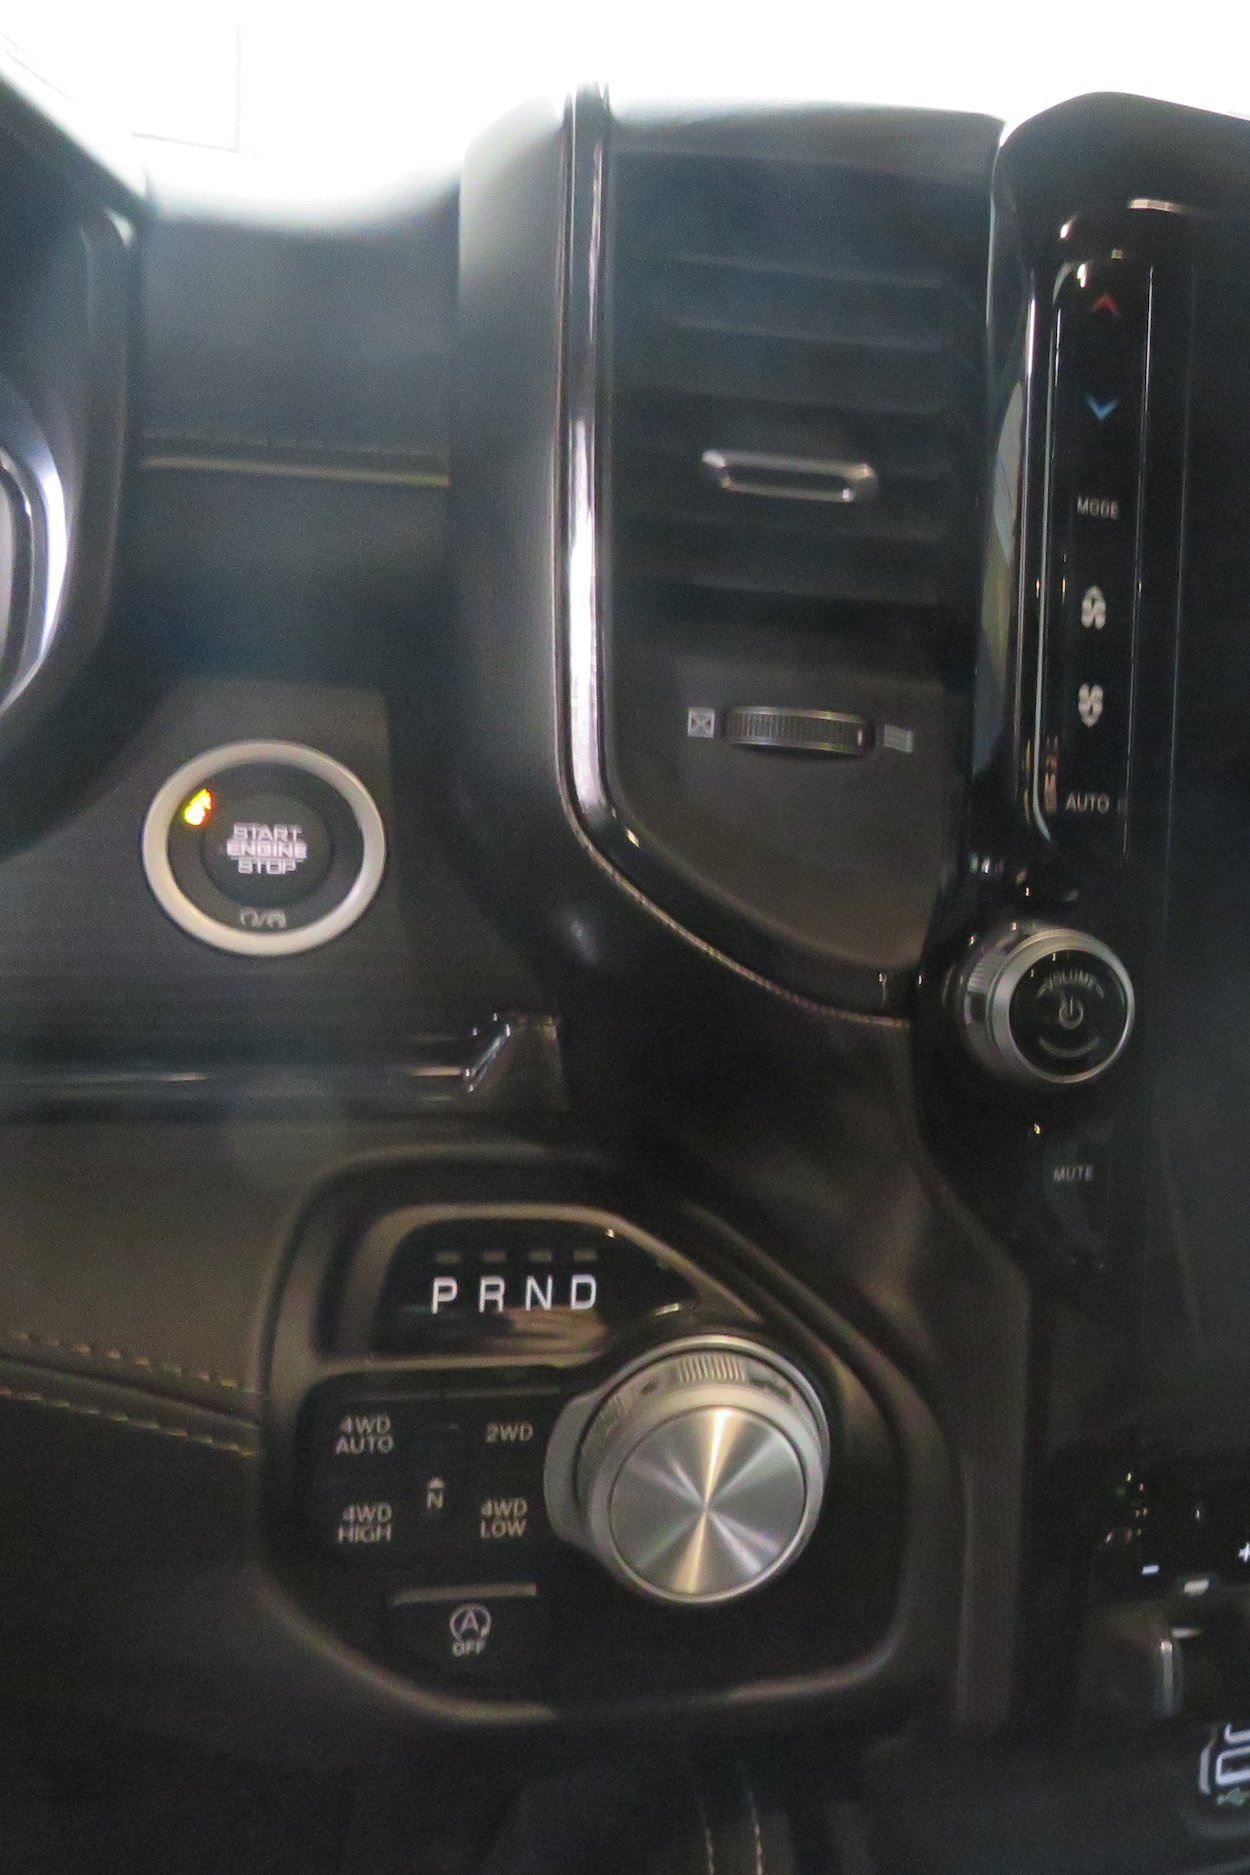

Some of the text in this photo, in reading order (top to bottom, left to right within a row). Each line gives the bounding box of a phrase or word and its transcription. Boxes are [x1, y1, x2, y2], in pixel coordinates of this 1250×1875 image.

[1065, 793, 1110, 814] AUTO
[233, 822, 303, 841] START
[226, 839, 308, 862] ENGINE
[237, 858, 297, 875] STOP
[431, 1273, 597, 1315] P R N D
[340, 1413, 392, 1434] 4WD
[485, 1421, 534, 1443] 2WD
[336, 1434, 395, 1456] AUTO
[342, 1502, 393, 1524] 4WD
[480, 1497, 528, 1519] 4WD
[337, 1521, 393, 1545] HIGH
[479, 1518, 527, 1539] LOW
